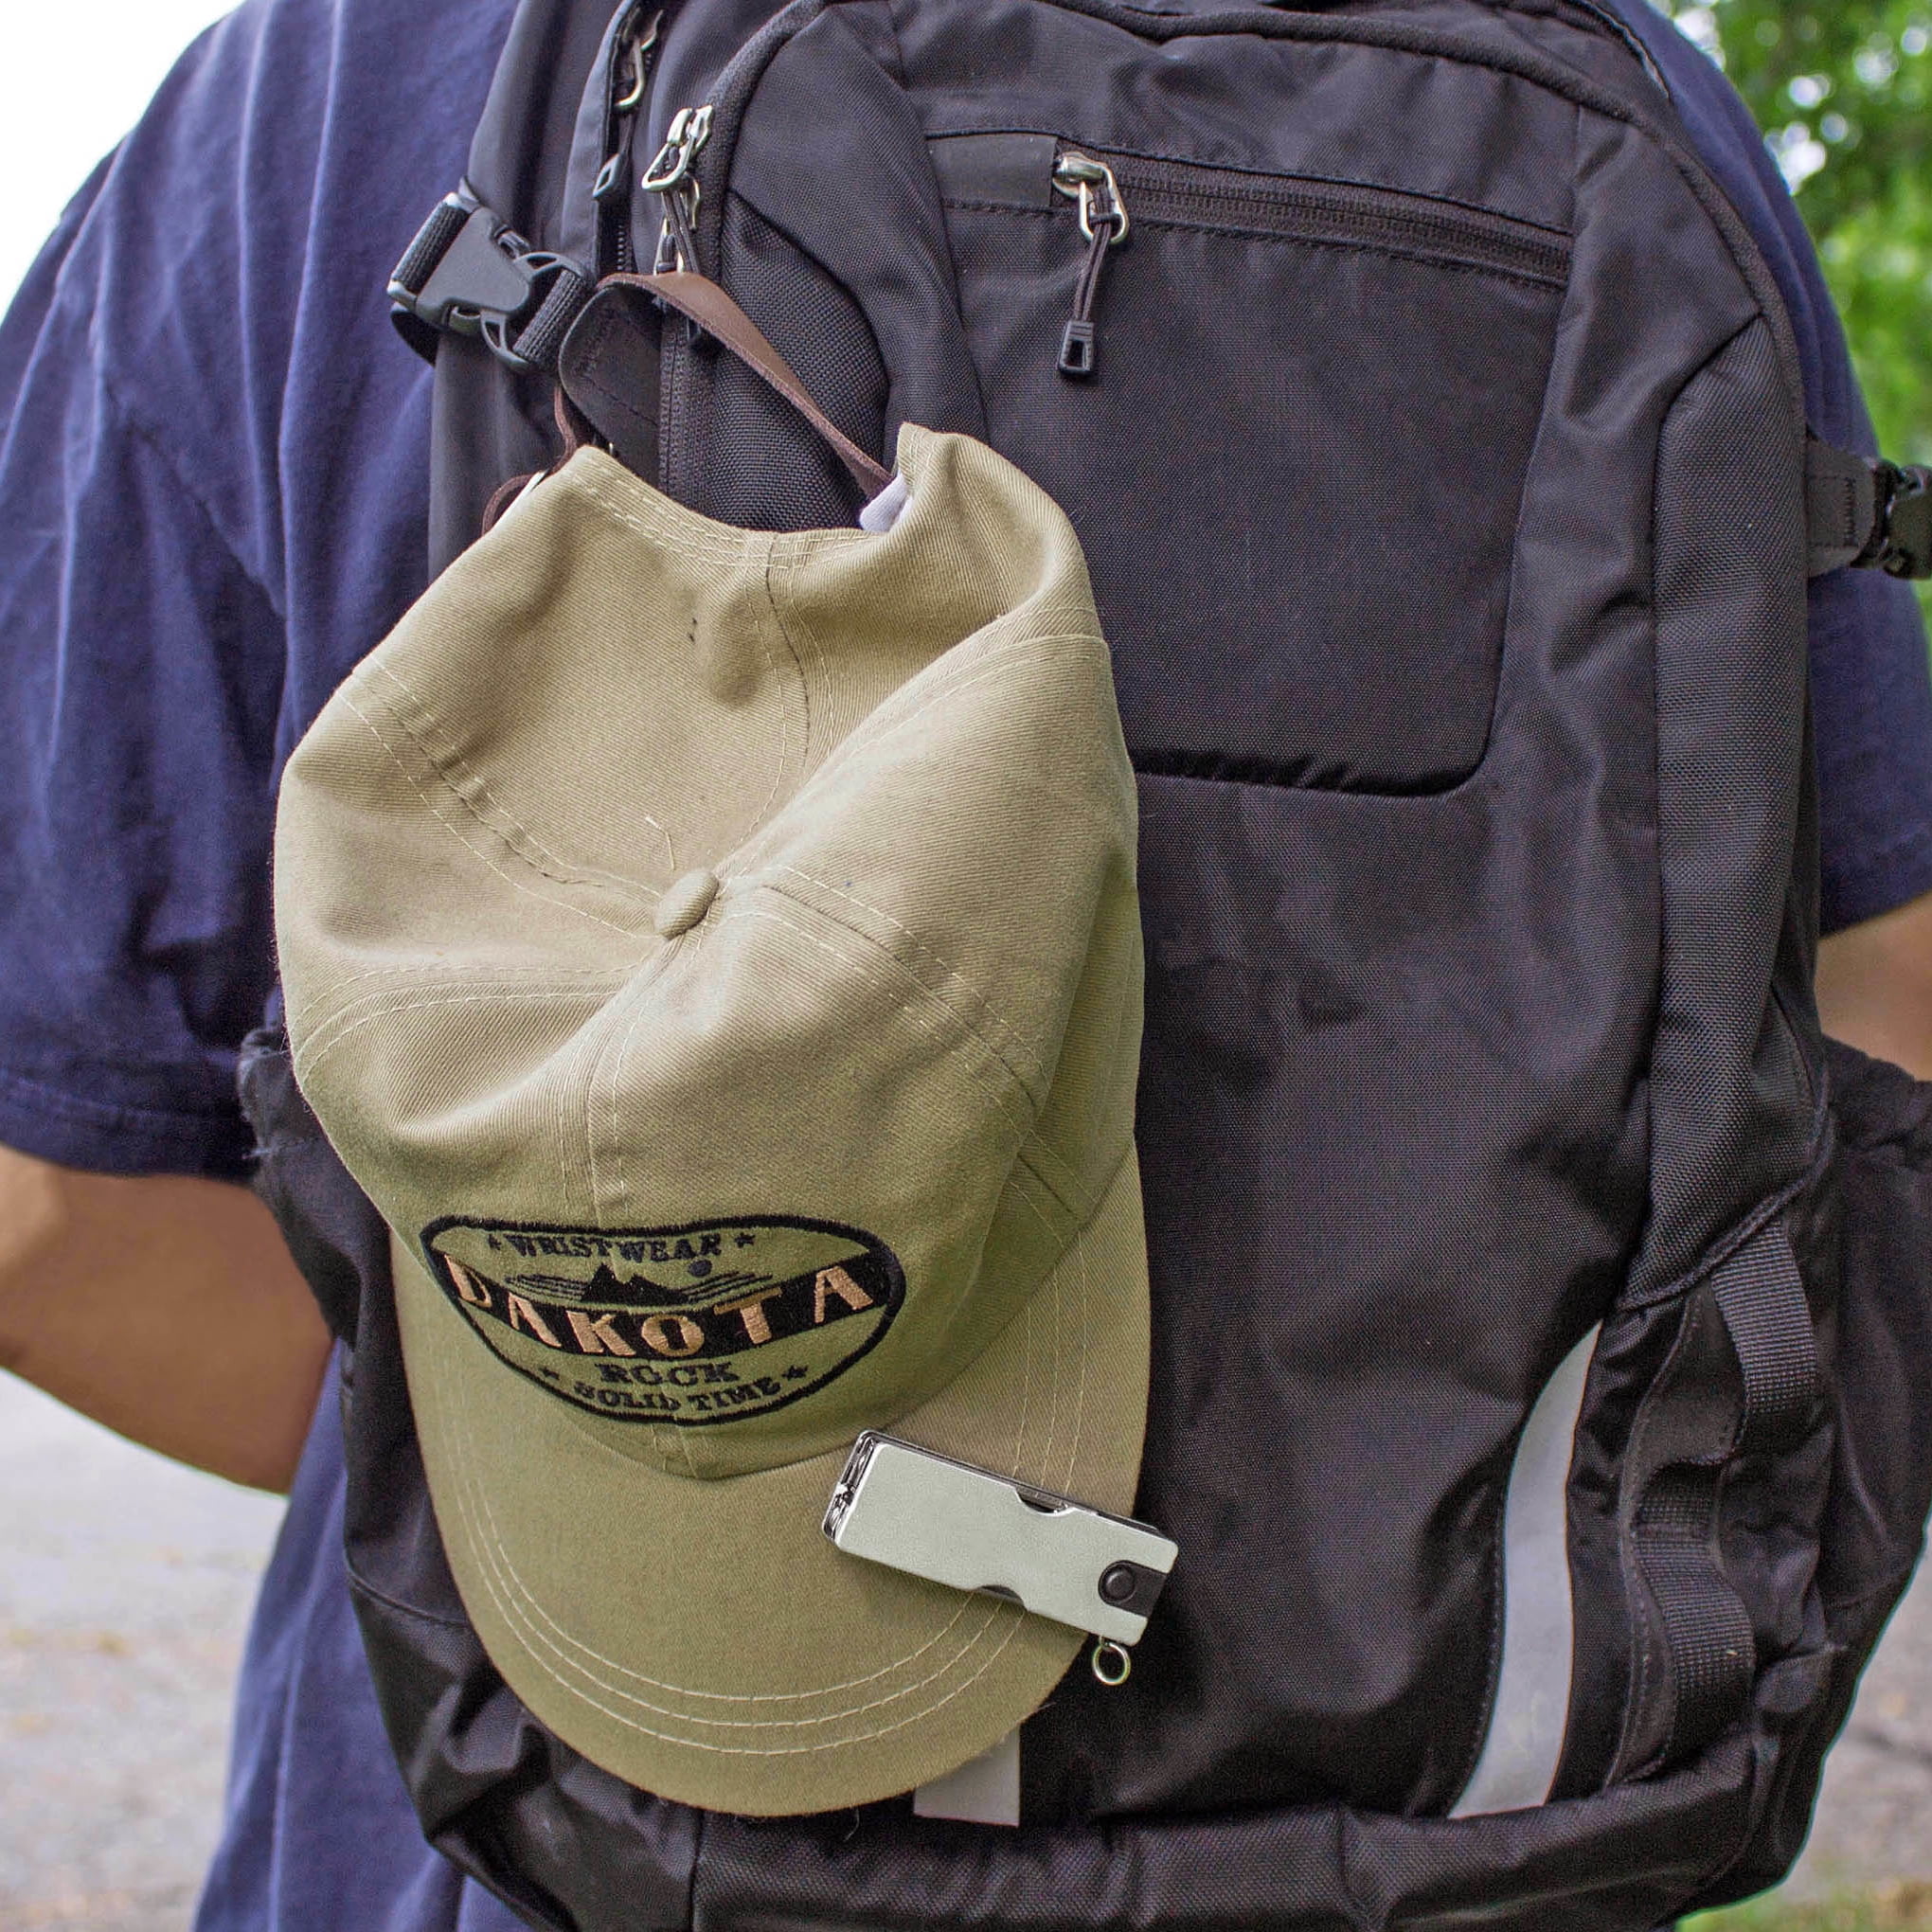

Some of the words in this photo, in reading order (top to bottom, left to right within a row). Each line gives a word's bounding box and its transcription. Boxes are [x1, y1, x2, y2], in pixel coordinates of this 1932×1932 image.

[504, 1233, 722, 1263] WRISTWEAR
[443, 1253, 874, 1357] DAKOTA
[594, 1361, 741, 1387] ROCK
[573, 1381, 682, 1412] SOLID
[685, 1375, 782, 1412] TIME
